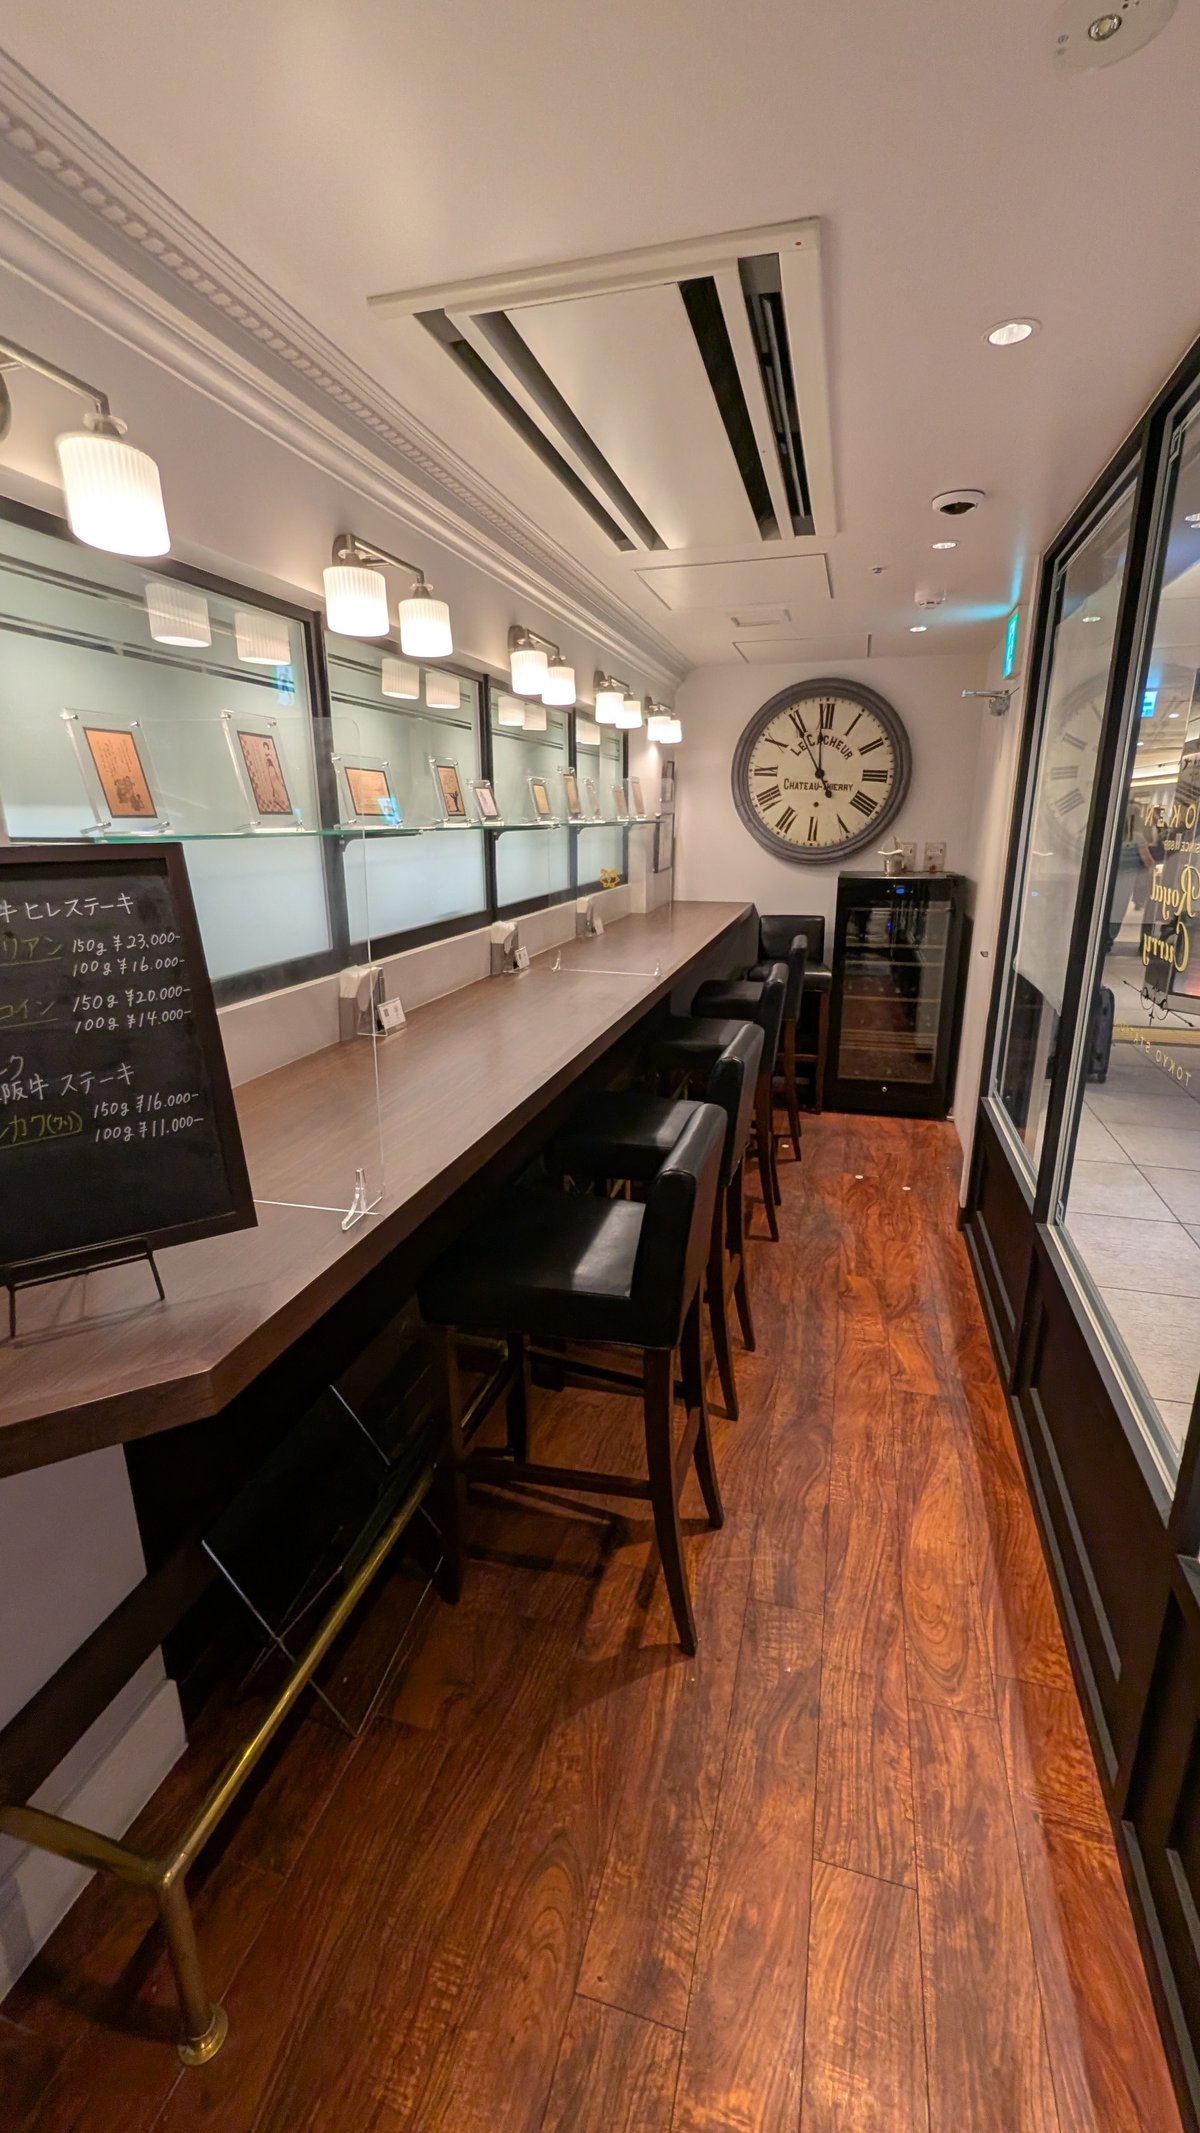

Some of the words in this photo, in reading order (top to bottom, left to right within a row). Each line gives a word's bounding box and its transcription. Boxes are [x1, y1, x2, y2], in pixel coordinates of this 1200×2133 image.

[790, 741, 808, 757] LE
[862, 769, 888, 783] III
[72, 939, 107, 956] 150g
[72, 960, 112, 977] 100g
[72, 994, 118, 1013] 150g
[74, 1017, 119, 1034] 100g
[93, 1101, 130, 1119] 150g
[95, 1125, 134, 1142] 100g
